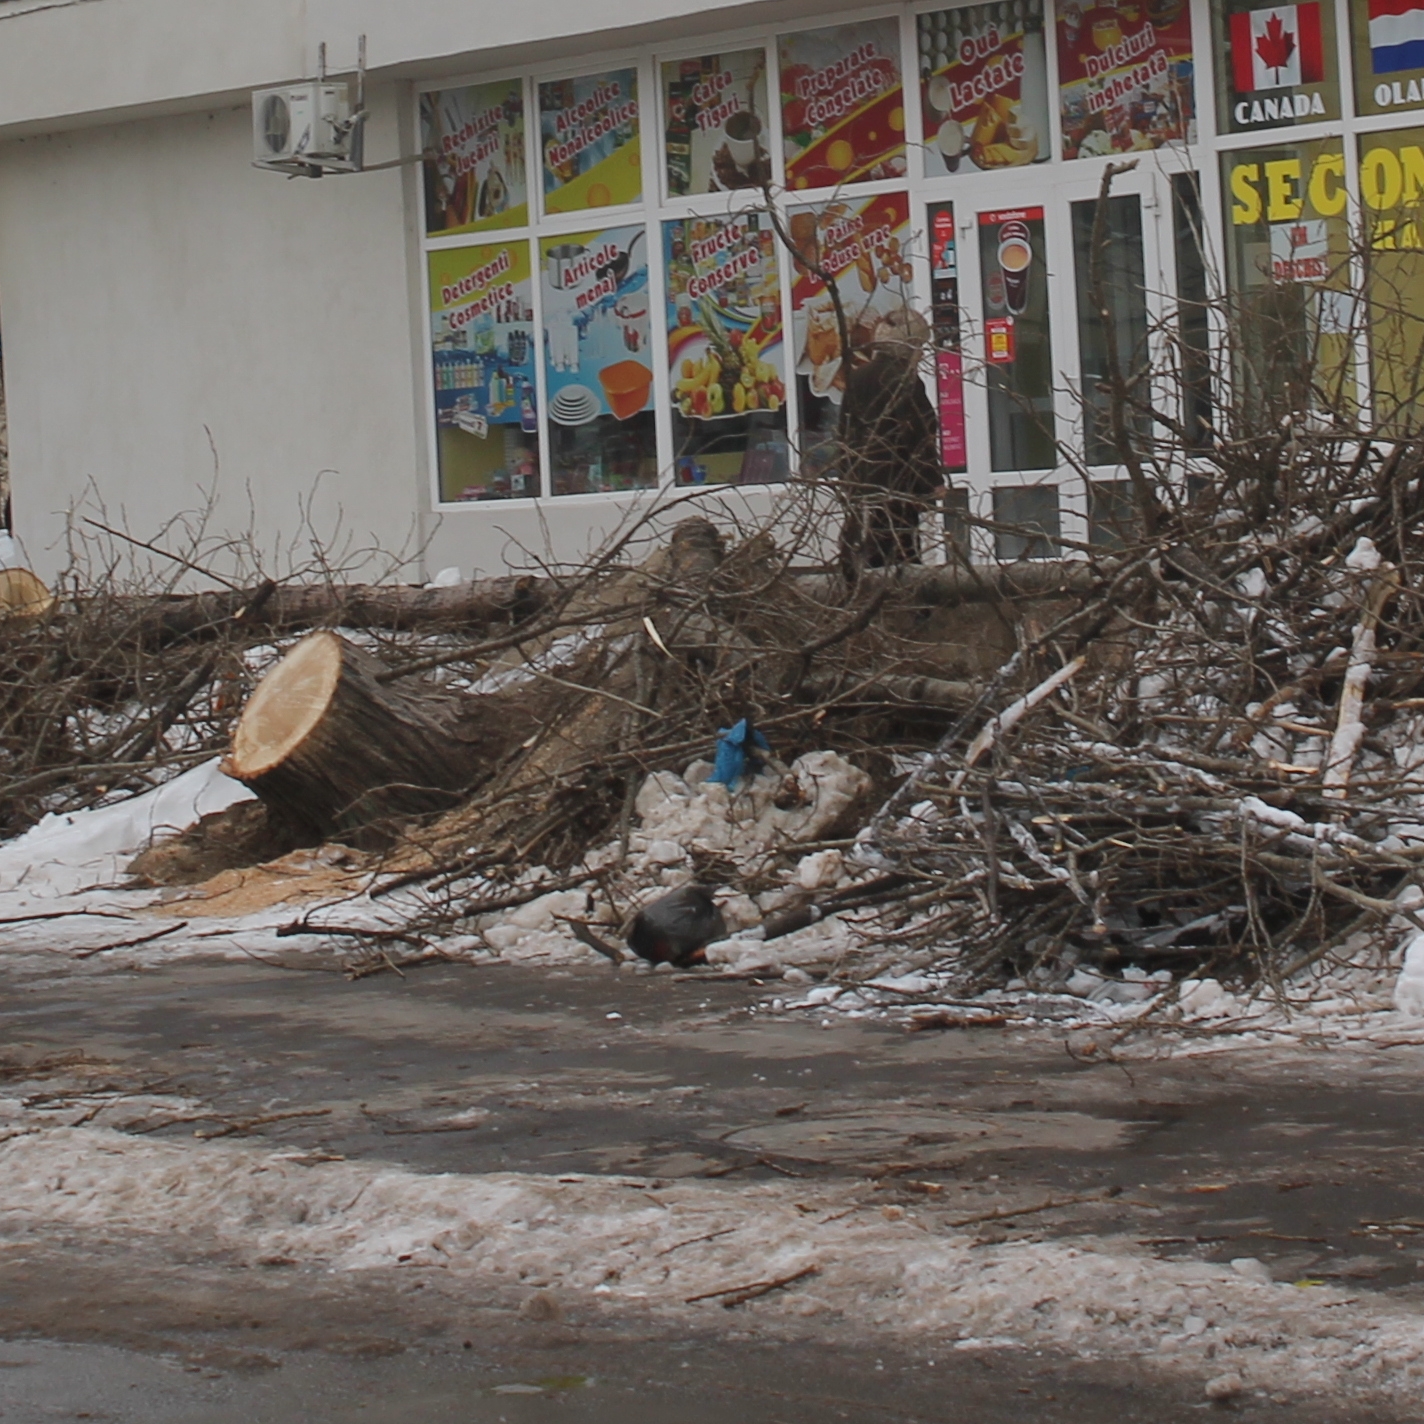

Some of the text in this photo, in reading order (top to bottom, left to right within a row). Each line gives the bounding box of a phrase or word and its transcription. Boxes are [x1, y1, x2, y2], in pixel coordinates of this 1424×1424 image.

[800, 43, 875, 98] Preparate
[1086, 22, 1155, 78] Dulciuri
[555, 82, 621, 133] Alcoolice
[692, 71, 732, 104] Cafea
[806, 70, 882, 125] Congelate
[949, 53, 1025, 111] Lactate
[442, 106, 504, 153] Rechizite
[548, 101, 638, 165] Nonalcoolice
[1235, 92, 1326, 125] CANADA
[563, 243, 619, 287] Articole
[691, 225, 742, 263] Fructe
[442, 250, 510, 304] Detergenti
[576, 270, 618, 309] menaj
[687, 247, 759, 299] Conserve
[449, 282, 514, 329] Cosmetice
